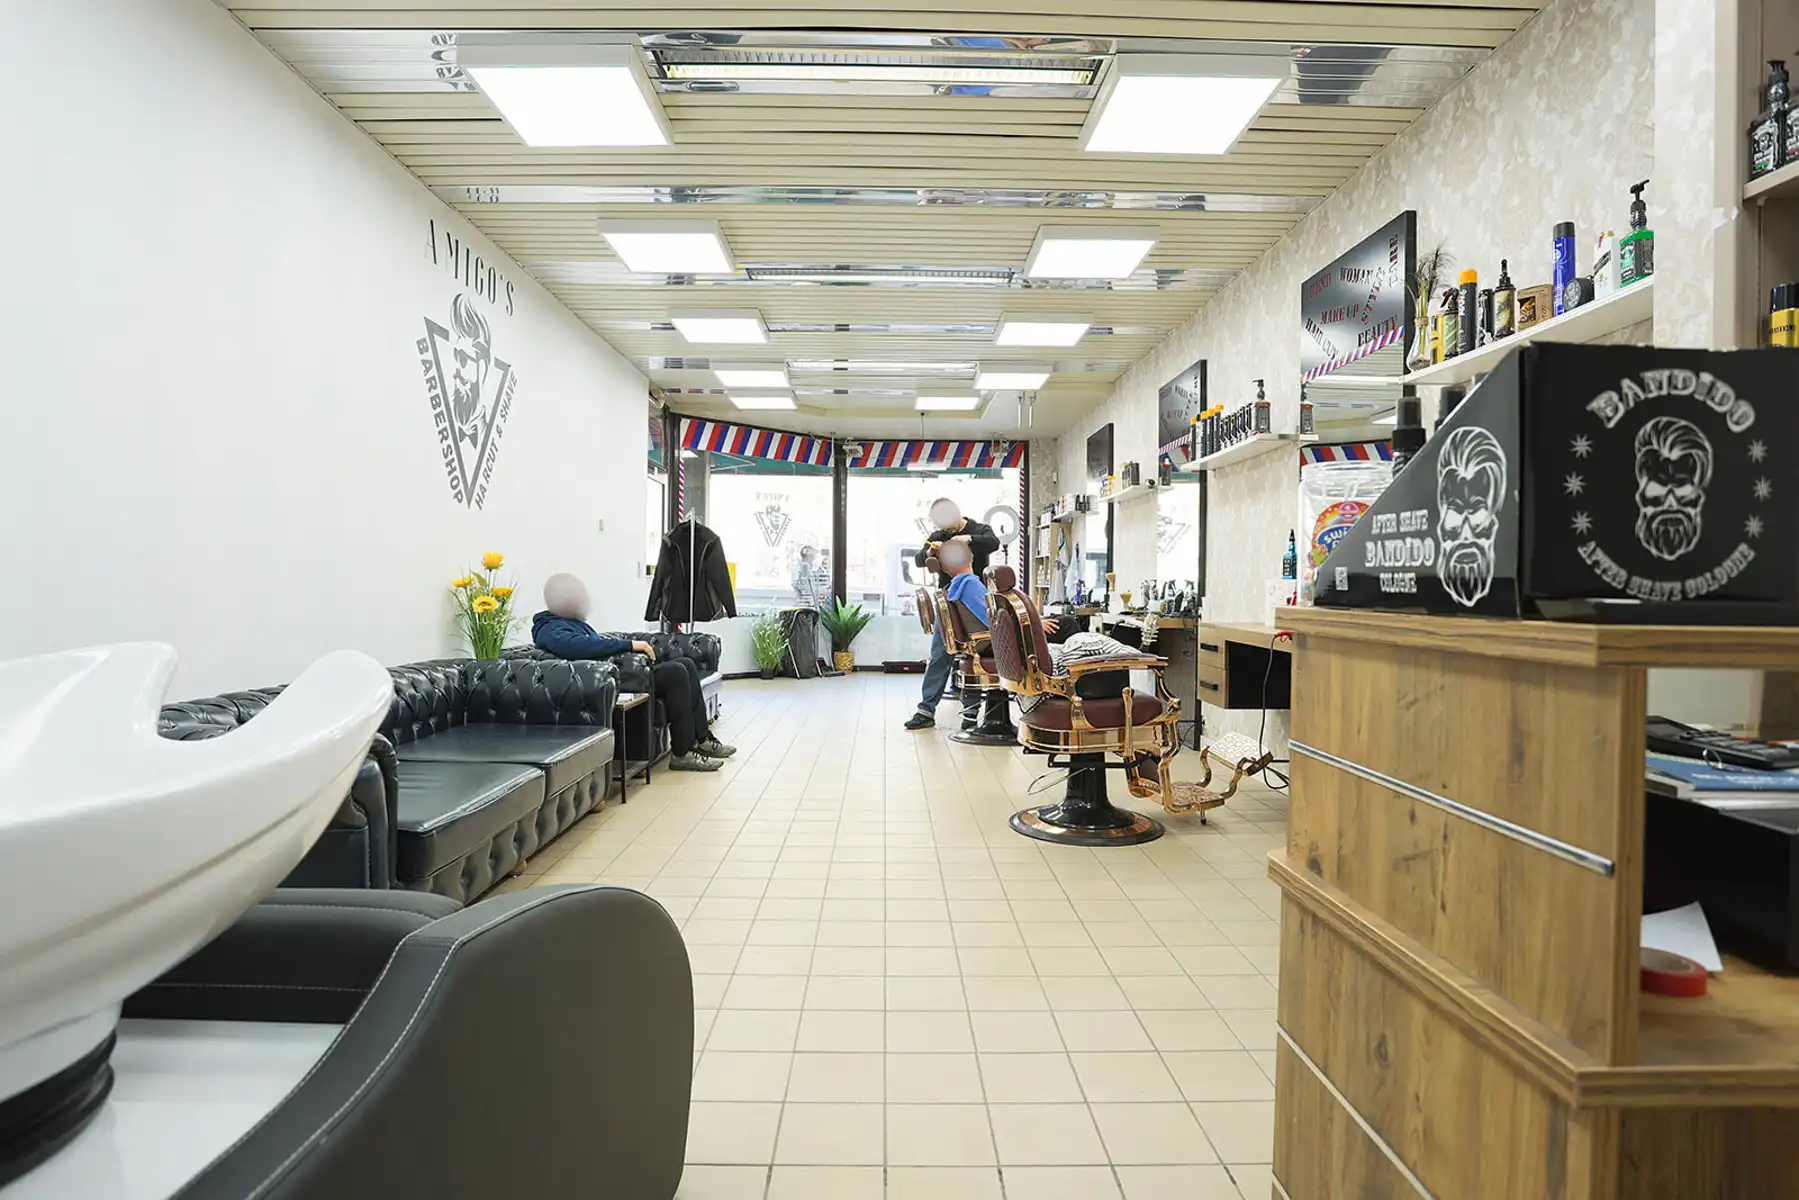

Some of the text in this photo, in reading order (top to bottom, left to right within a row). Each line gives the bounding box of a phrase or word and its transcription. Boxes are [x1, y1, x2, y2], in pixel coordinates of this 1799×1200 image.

[416, 337, 464, 503] BARBERSHOP
[475, 438, 499, 511] HARCUT
[500, 370, 518, 423] SHAVE
[1371, 509, 1428, 534] AFTER SHAVE
[1576, 540, 1756, 600] AFTER SHAVE COLOGNE
